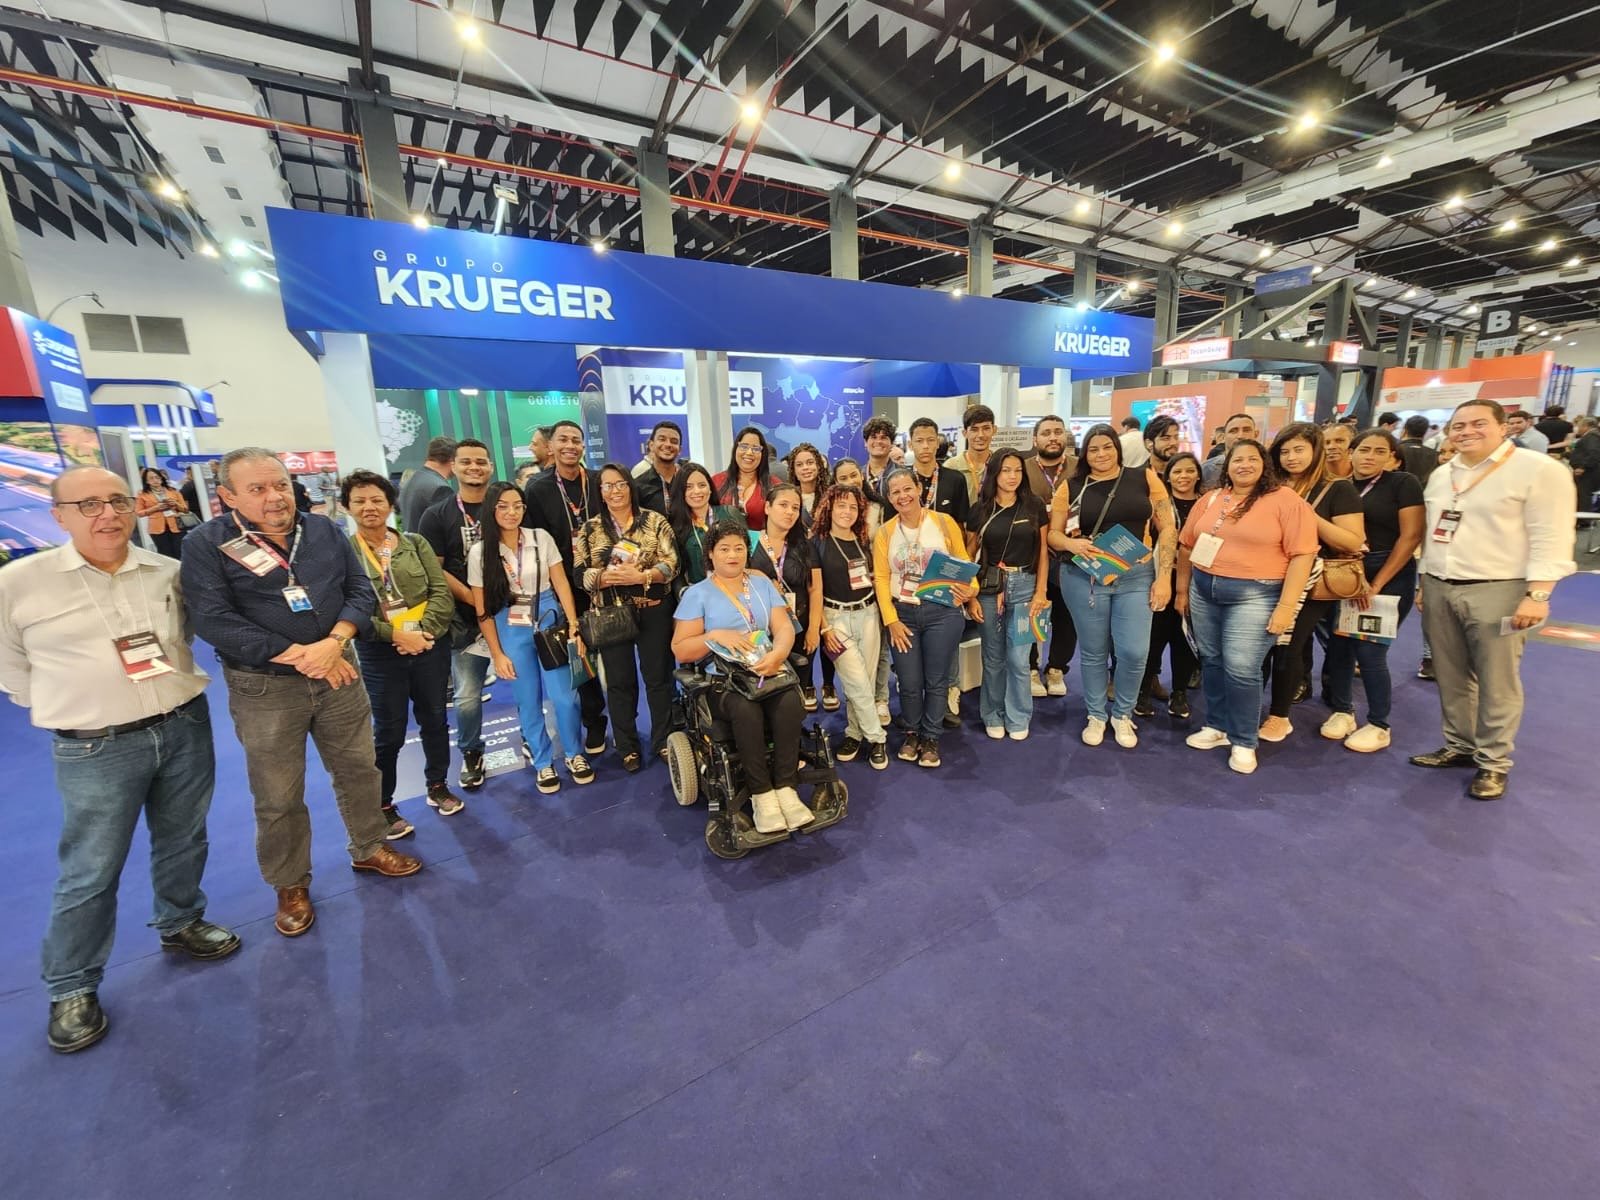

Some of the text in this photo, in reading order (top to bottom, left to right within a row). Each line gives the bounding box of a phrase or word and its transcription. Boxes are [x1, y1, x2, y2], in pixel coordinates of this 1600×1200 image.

[373, 249, 503, 273] GRUPO
[375, 266, 615, 321] KRUEGER
[1486, 310, 1511, 333] B
[1054, 331, 1130, 357] KRUEGER
[629, 384, 755, 407] KRUER
